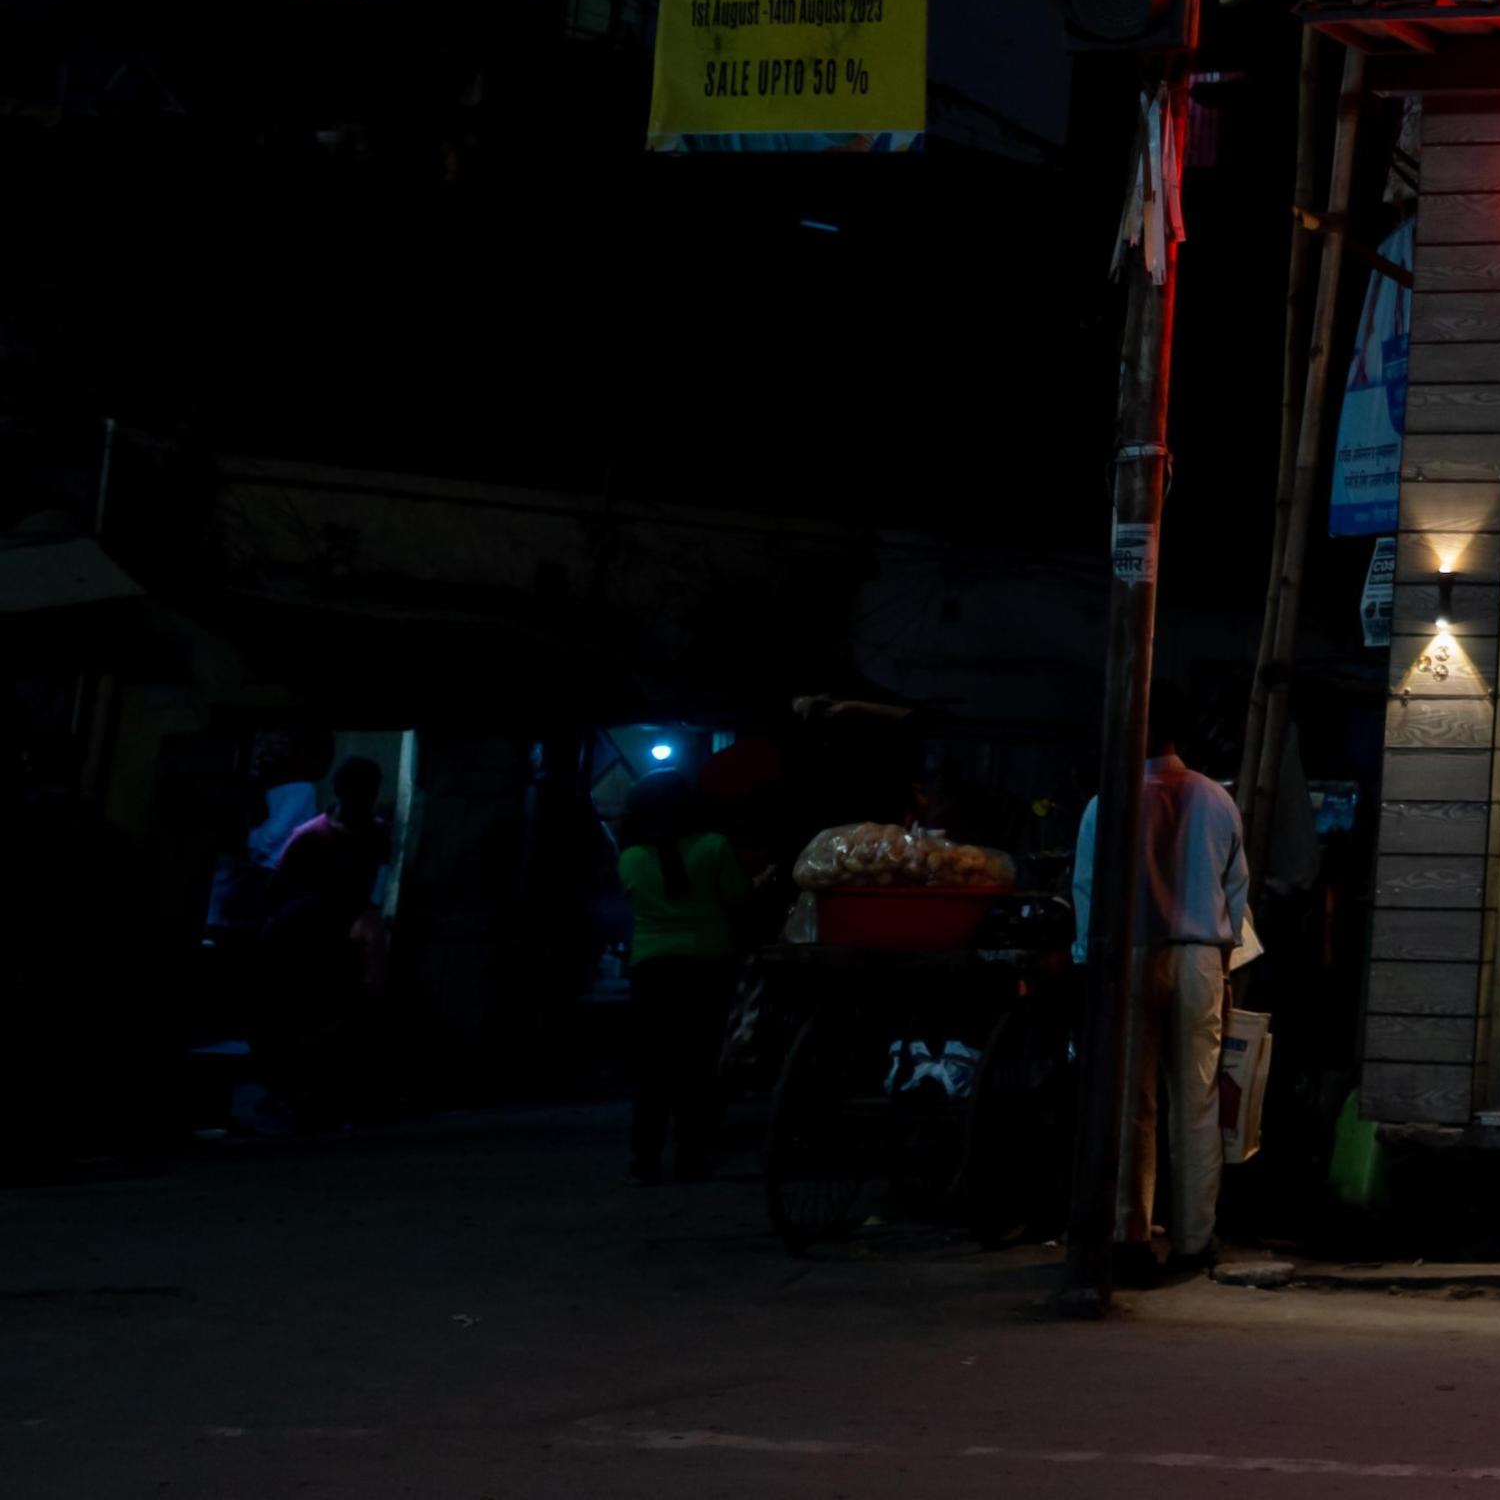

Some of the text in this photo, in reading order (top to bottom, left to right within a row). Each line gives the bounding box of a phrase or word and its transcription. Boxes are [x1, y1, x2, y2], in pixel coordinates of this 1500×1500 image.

[704, 58, 869, 97] SALE UPTO 50 %
